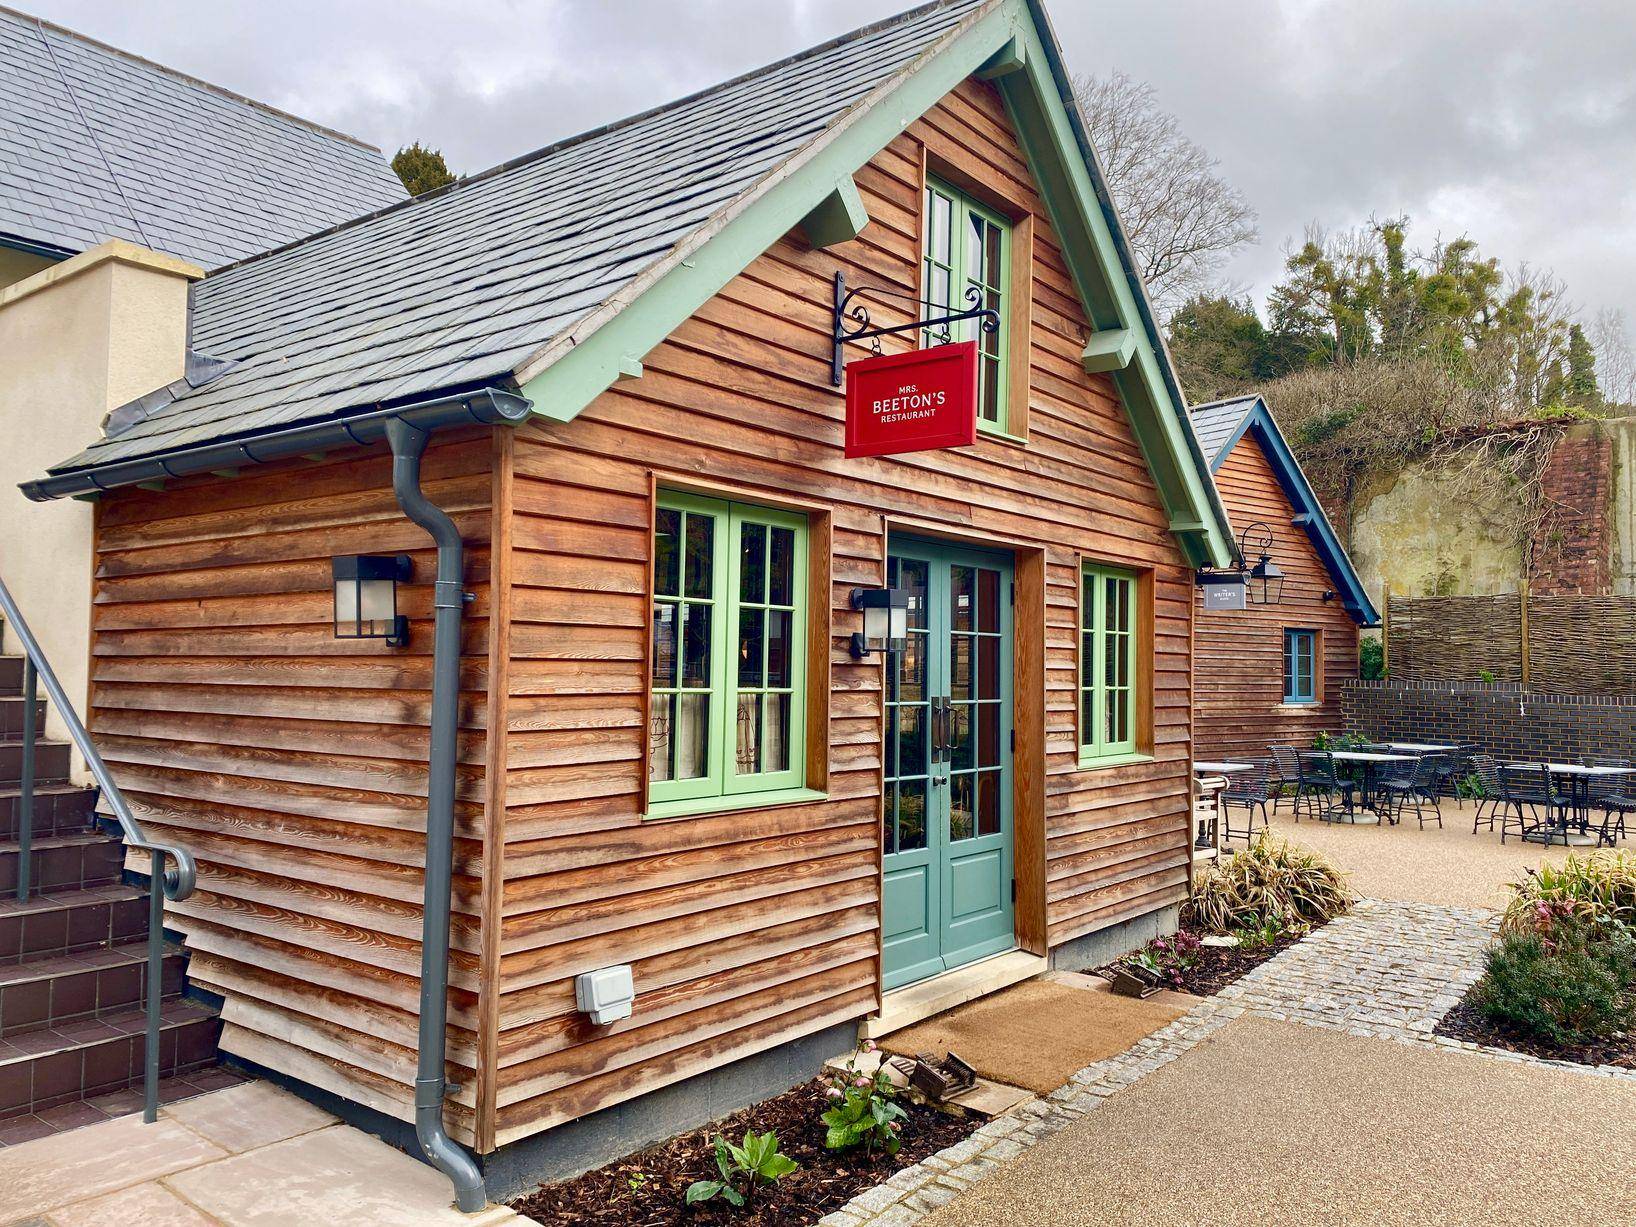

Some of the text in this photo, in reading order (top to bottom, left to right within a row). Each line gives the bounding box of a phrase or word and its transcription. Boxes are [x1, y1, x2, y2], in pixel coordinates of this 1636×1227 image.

[898, 384, 919, 395] MRS.
[872, 391, 946, 414] BEETON'S
[881, 408, 936, 423] RESTAURANT
